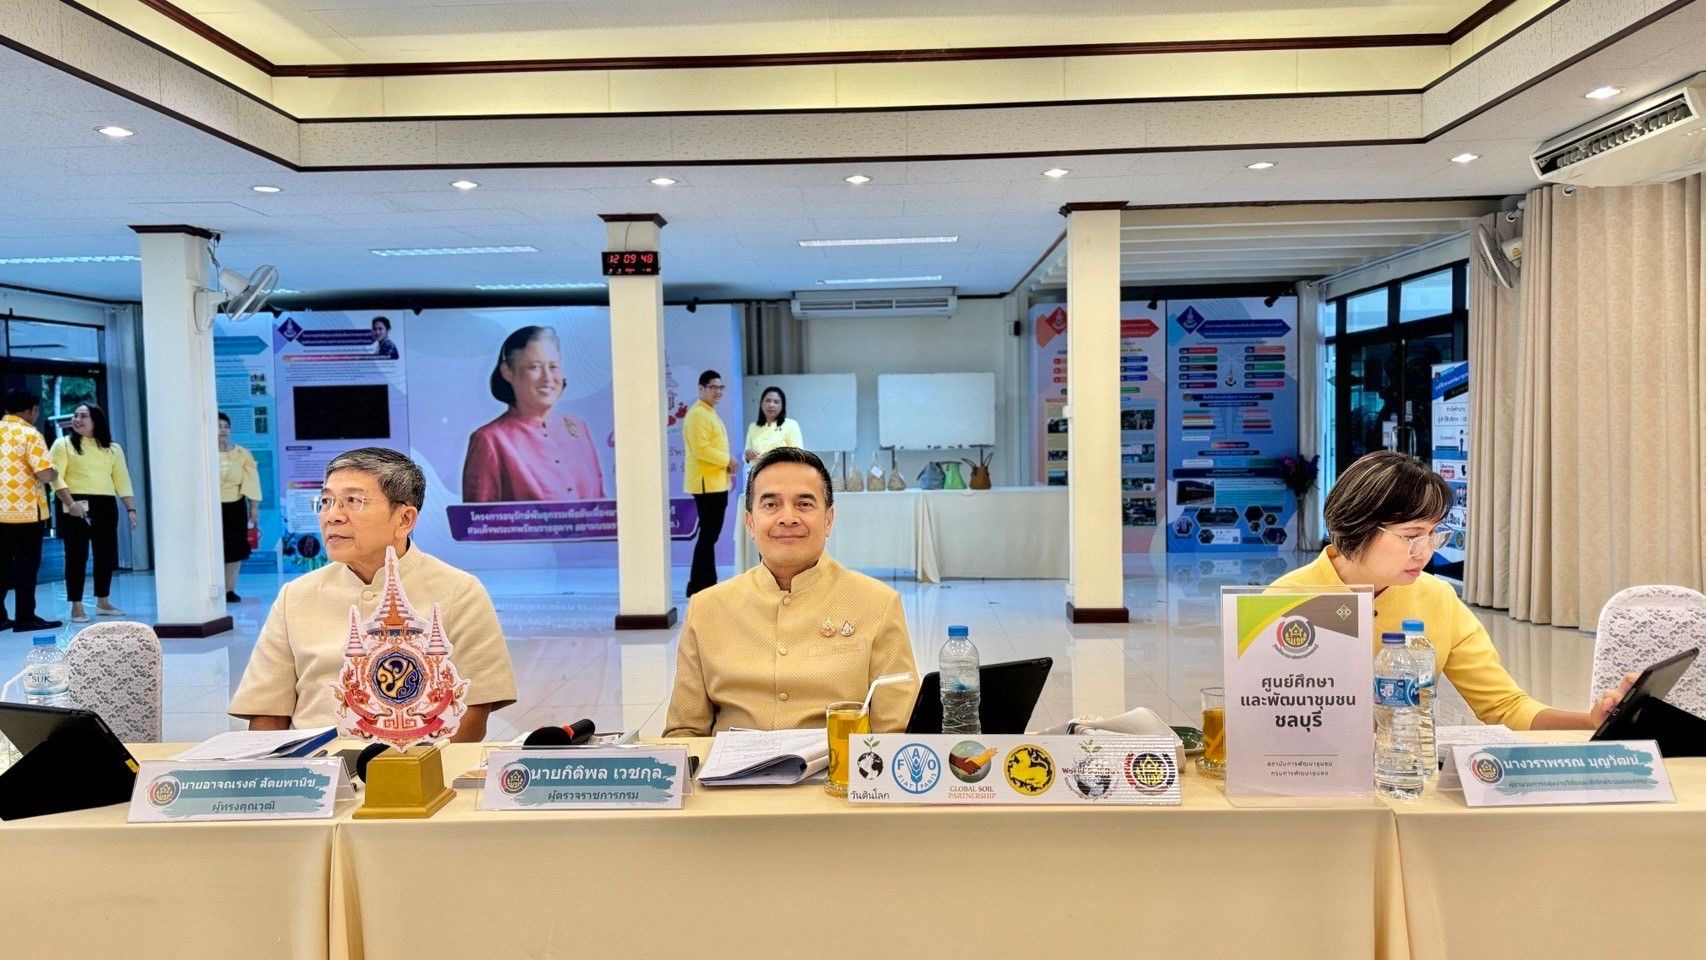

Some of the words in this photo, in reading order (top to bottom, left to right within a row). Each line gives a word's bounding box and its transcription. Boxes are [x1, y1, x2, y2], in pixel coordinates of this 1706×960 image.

[610, 254, 620, 264] 12
[624, 254, 636, 264] 09
[641, 254, 654, 264] 48
[1261, 673, 1335, 693] ศูนย์ศึกษา
[1240, 692, 1356, 710] และพัฒนาชุมชน
[1274, 709, 1323, 732] ชลบุรี
[1503, 757, 1585, 770] นางวราพรรณ
[1587, 754, 1640, 770] บุญวัฒน์
[613, 766, 662, 782] เวชกุล
[548, 789, 639, 802] ผู้ตรวจราชการกรม
[850, 787, 890, 800] วันดินโลก
[212, 800, 276, 813] ผู้ทรงคุณวุฒิ
